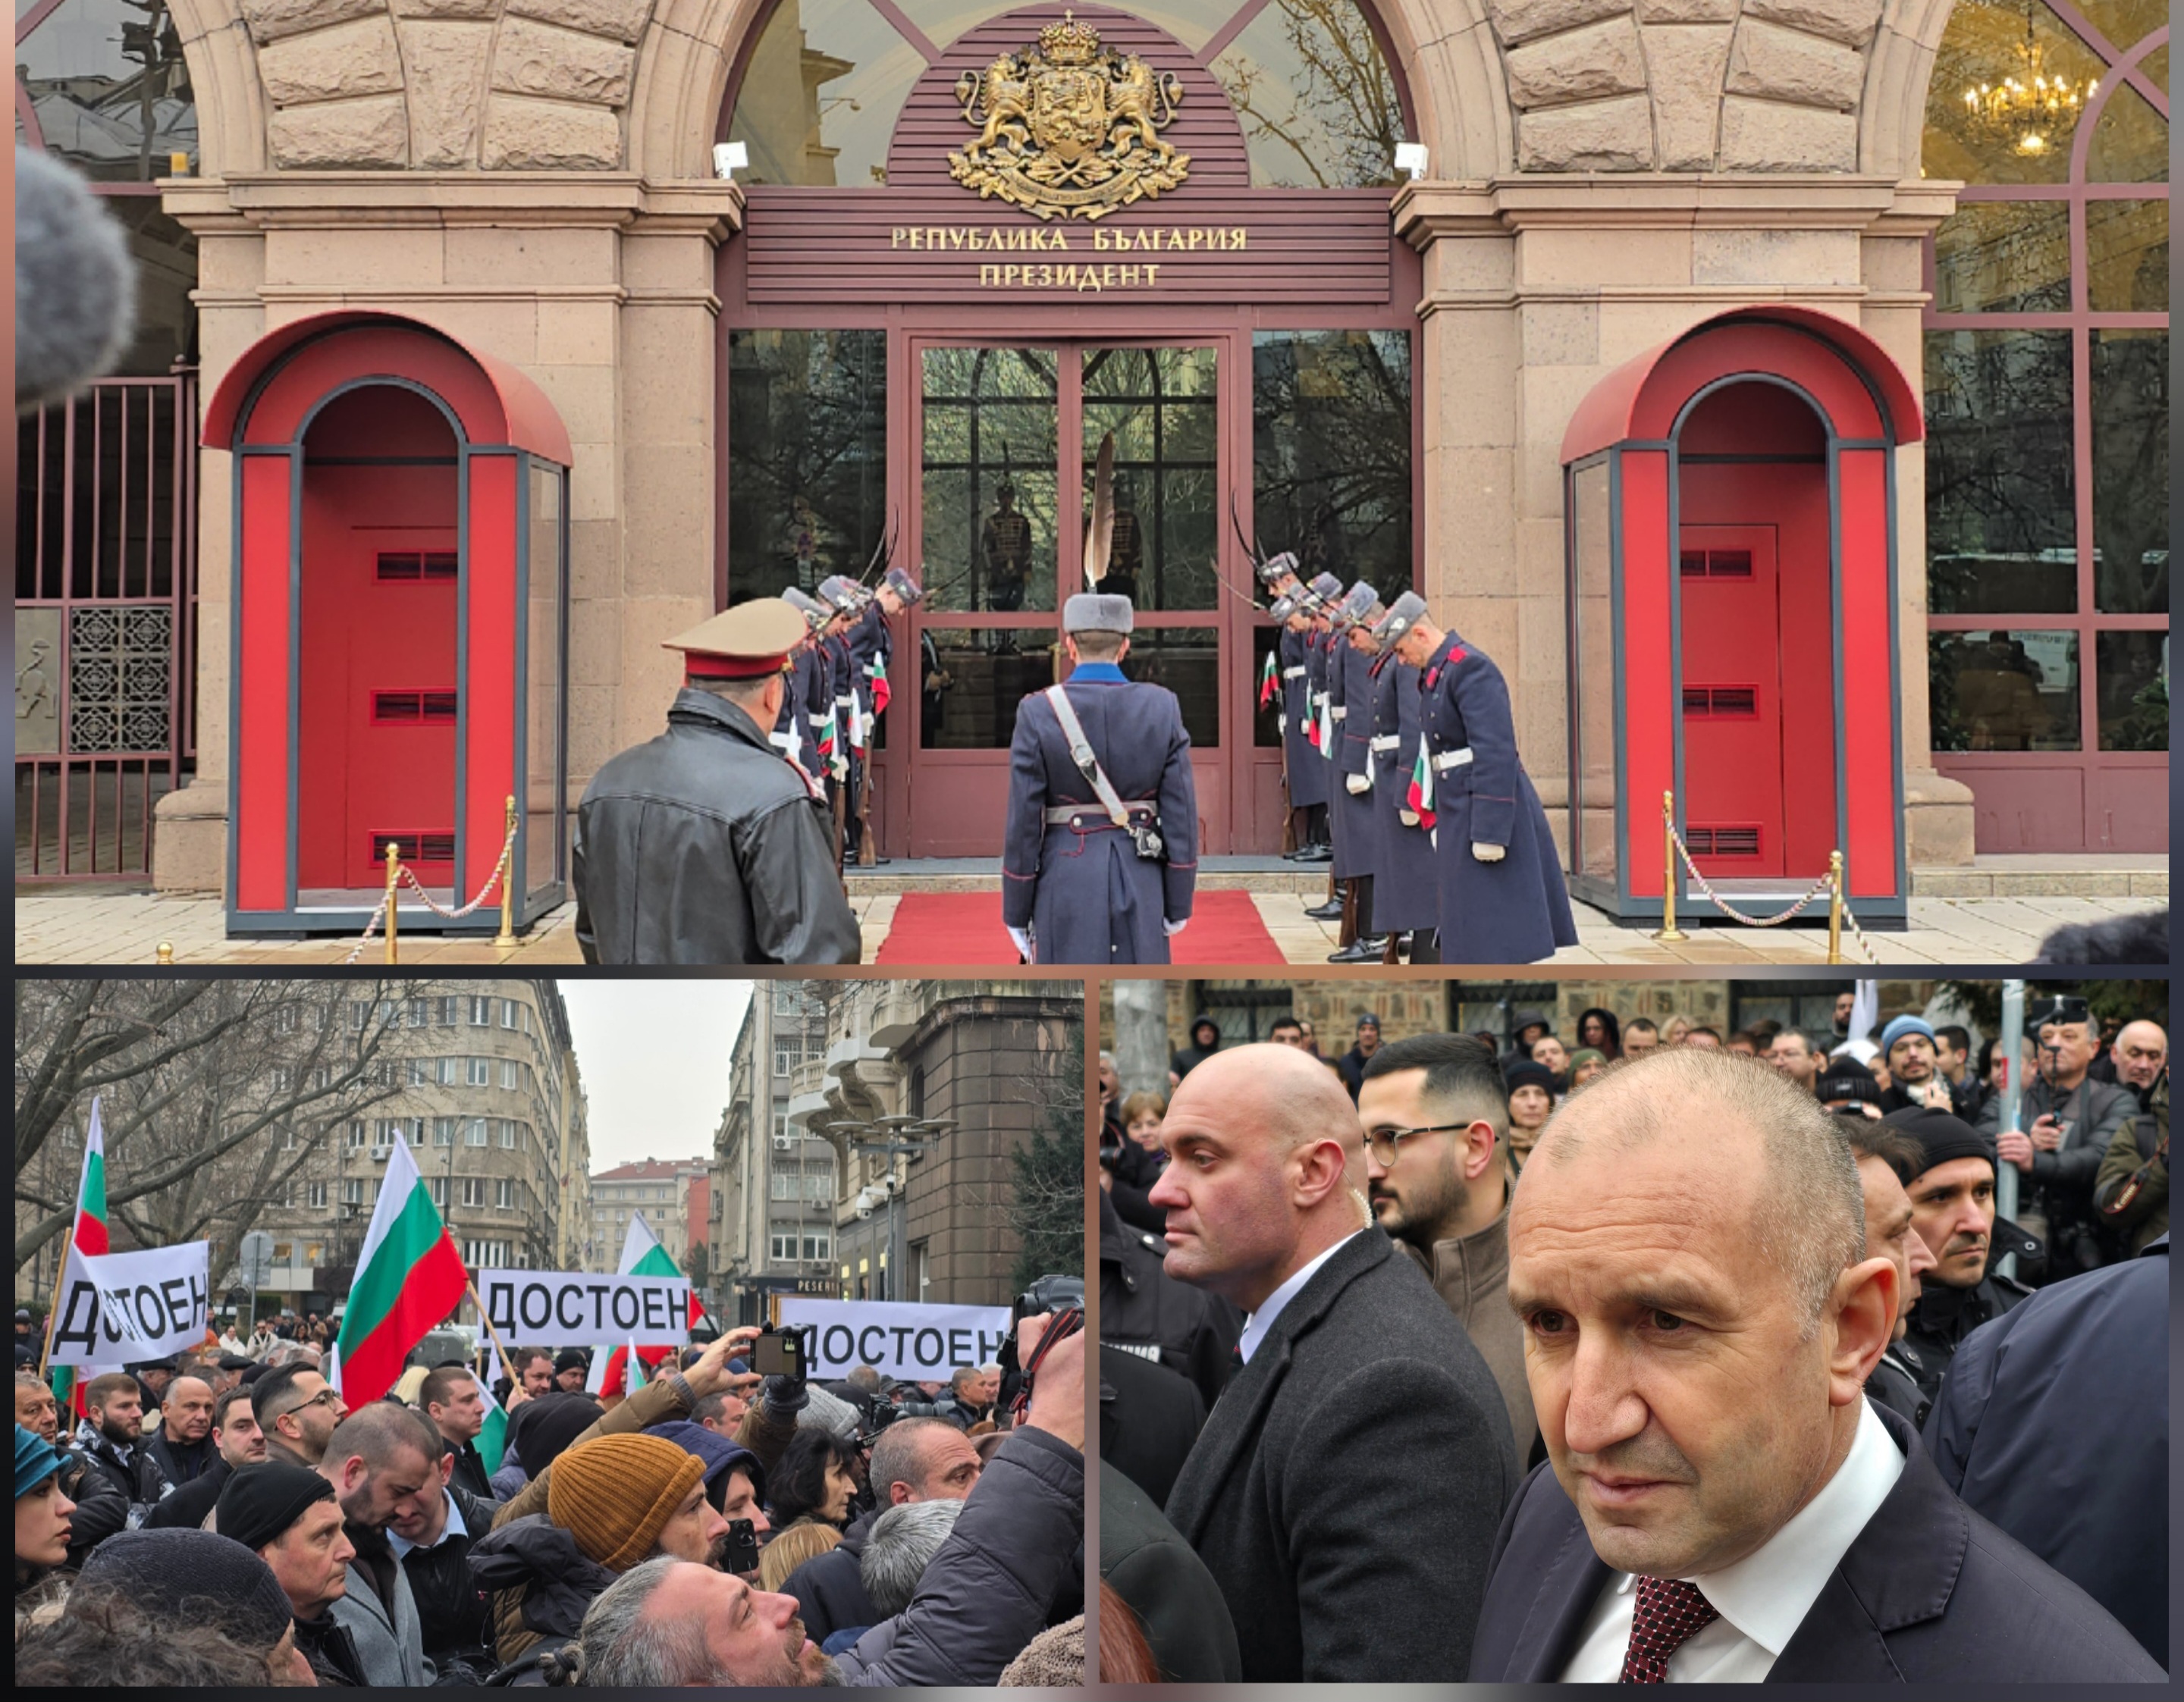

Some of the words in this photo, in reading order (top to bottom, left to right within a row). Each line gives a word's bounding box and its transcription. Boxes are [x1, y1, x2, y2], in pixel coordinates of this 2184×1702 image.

[891, 227, 1069, 250] РЕПУБЛИКА
[1094, 227, 1247, 250] БЪЛГАРИЯ
[979, 264, 1160, 292] ПРЕЗИДЕНТ
[482, 1283, 688, 1339] ДОСТОЕН
